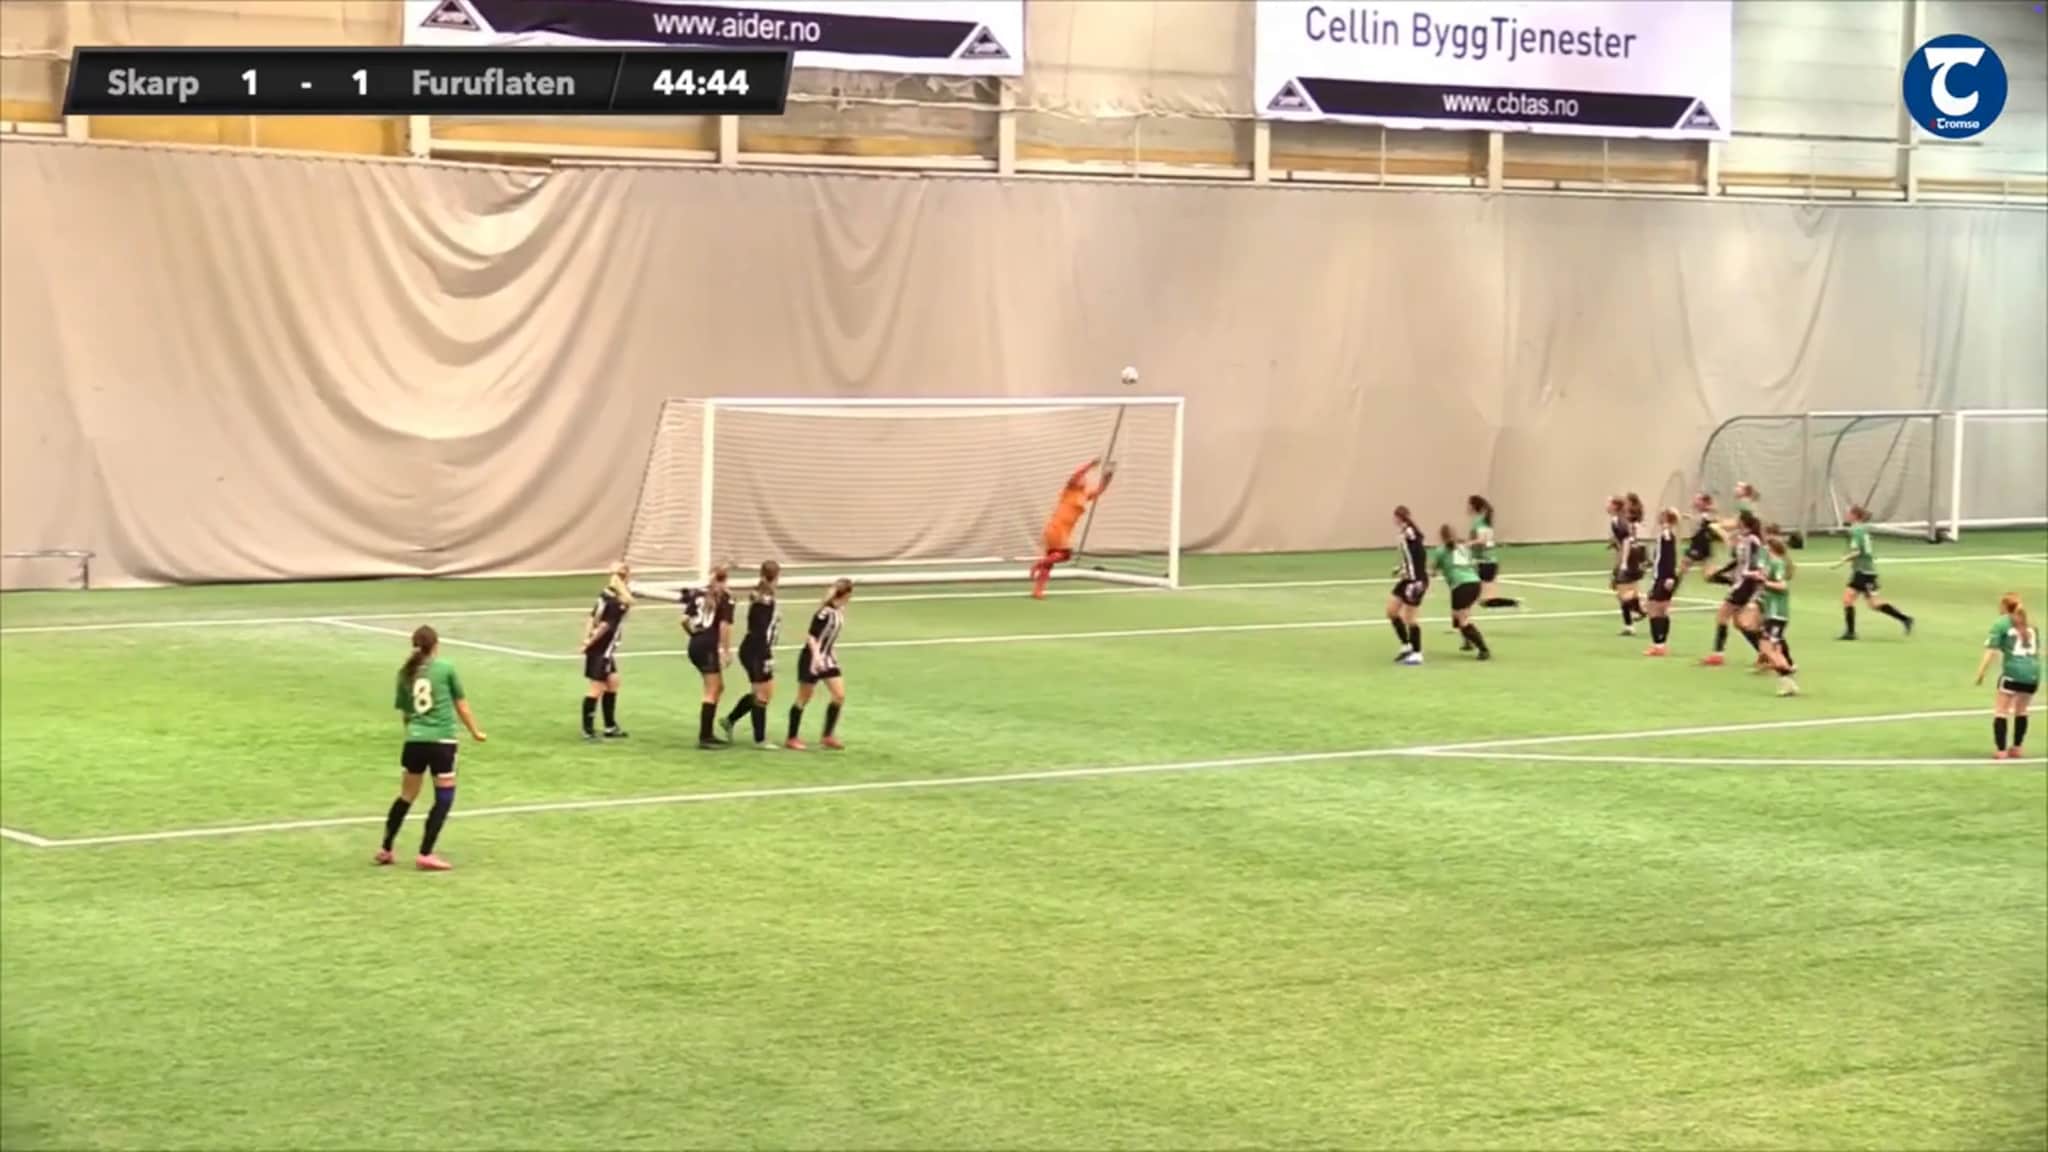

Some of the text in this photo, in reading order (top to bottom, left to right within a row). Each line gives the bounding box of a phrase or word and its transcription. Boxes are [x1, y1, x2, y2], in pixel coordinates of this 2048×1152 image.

[653, 12, 821, 42] www.aider.no
[1306, 6, 1637, 61] Cellin ByggTjenester
[1442, 91, 1579, 117] www.cbtas.no
[413, 678, 433, 714] 8
